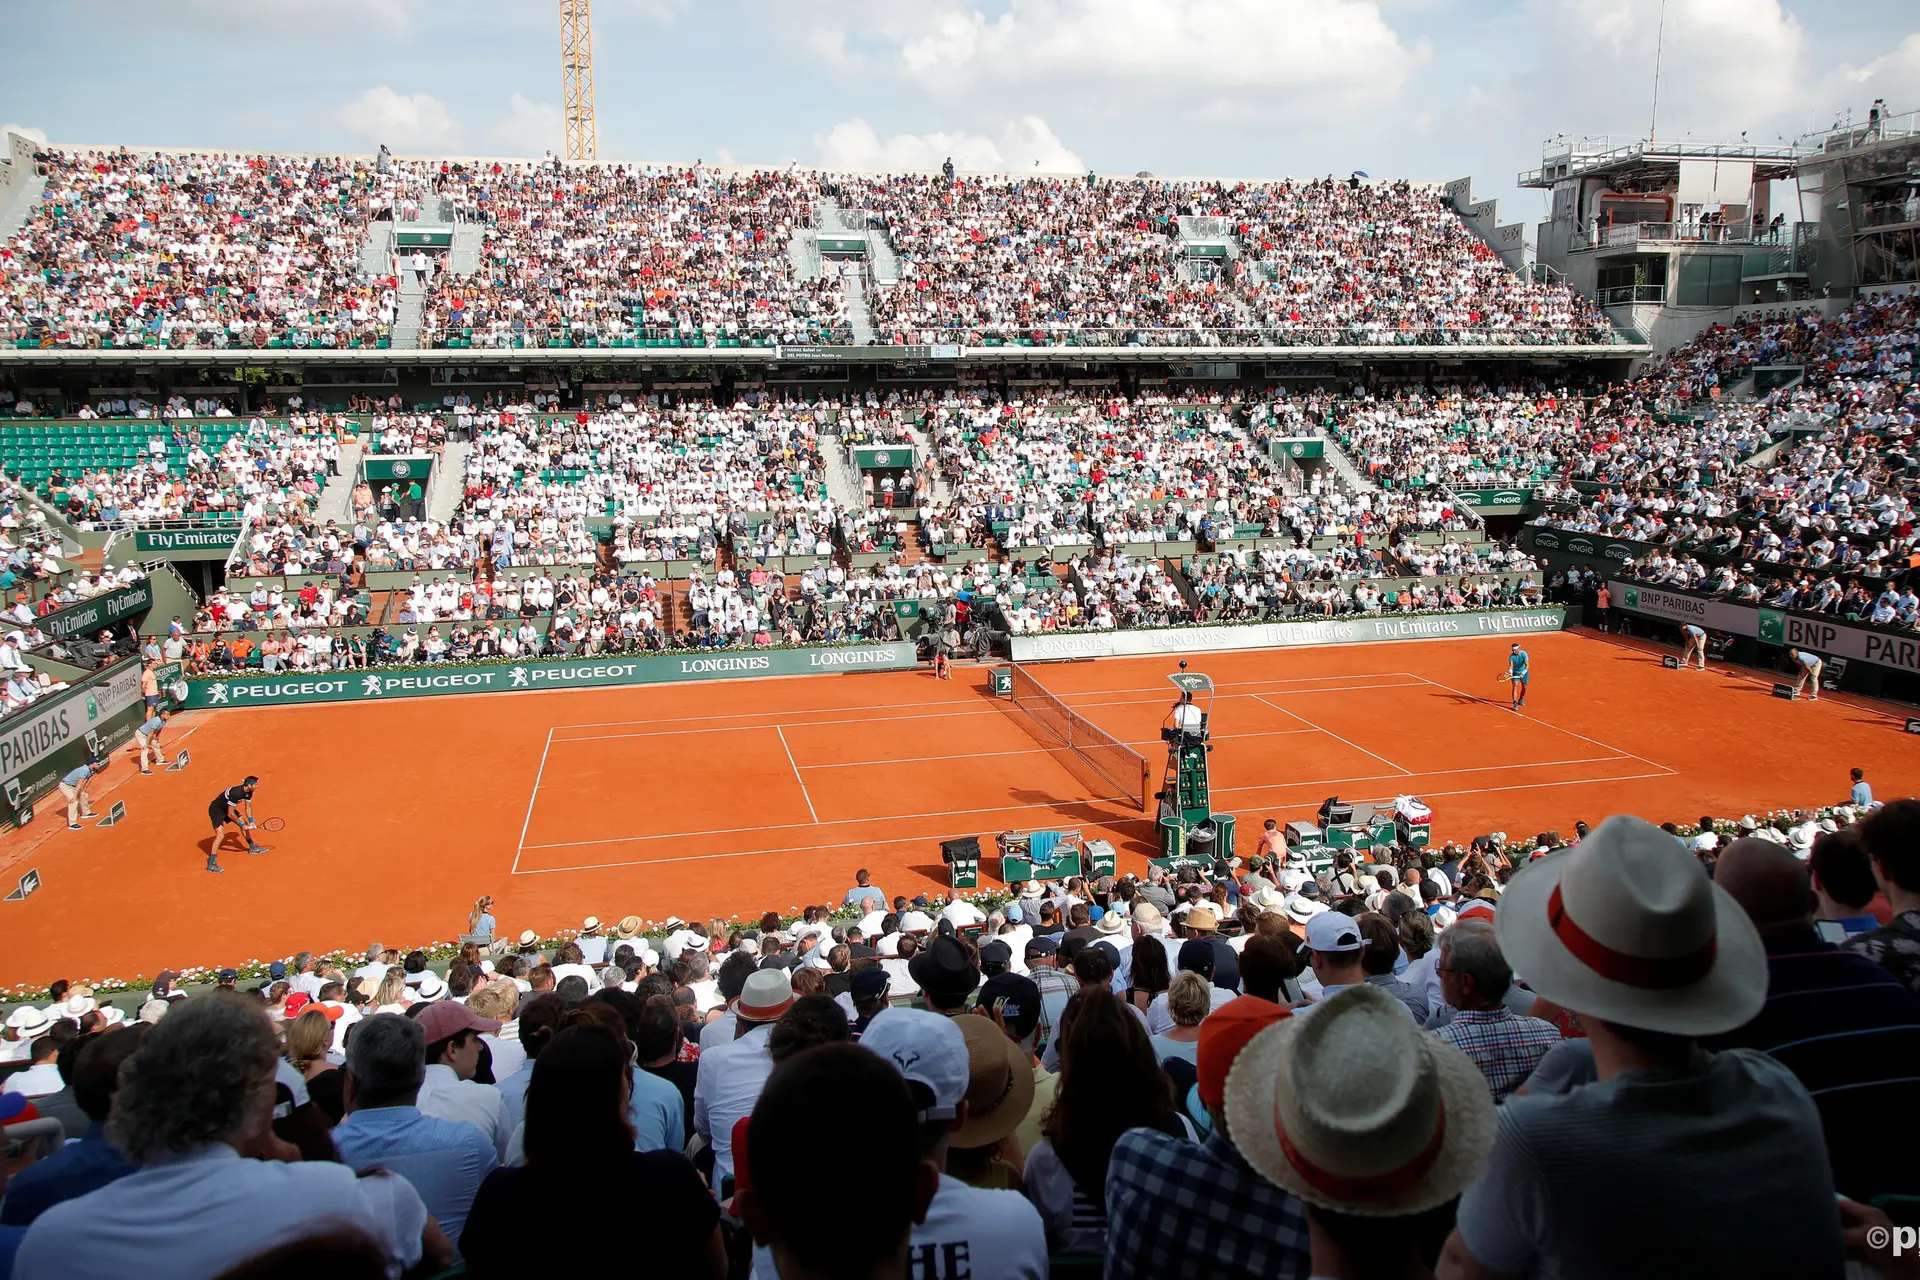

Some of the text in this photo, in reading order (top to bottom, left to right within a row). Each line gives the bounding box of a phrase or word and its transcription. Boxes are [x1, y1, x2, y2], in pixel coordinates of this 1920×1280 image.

[148, 531, 237, 548] Fly Emirates
[107, 588, 147, 616] Fly Emirates
[1641, 591, 1705, 614] BNP PARIBAS
[64, 608, 98, 633] Emirates
[1375, 619, 1458, 637] Fly Emirates
[1478, 613, 1559, 632] Fly Emirates
[1151, 631, 1228, 648] LONGINES
[1291, 624, 1353, 641] Emirates
[1788, 620, 1836, 649] BNP
[1032, 639, 1112, 653] LONGINES
[681, 656, 770, 673] LONGINES
[810, 649, 896, 666] LONGINES
[385, 672, 496, 690] PEUGEOT
[531, 664, 637, 681] PEUGEOT
[111, 674, 137, 699] PARIBAS
[232, 680, 349, 698] PEUGEOT
[0, 708, 70, 775] PARIBAS
